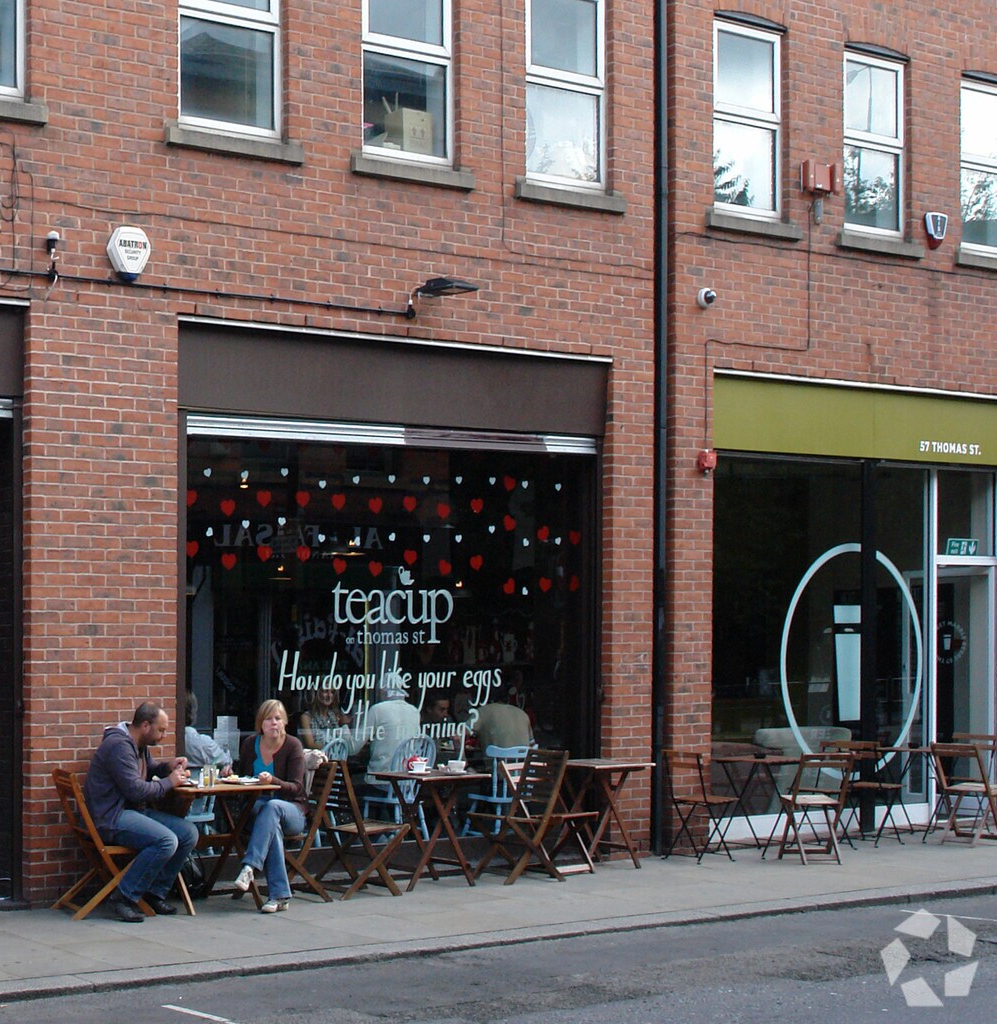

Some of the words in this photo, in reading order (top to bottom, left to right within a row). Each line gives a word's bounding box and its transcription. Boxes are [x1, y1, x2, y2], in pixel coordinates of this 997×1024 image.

[119, 239, 147, 249] ABATRON
[919, 440, 930, 452] 57
[931, 441, 968, 455] THOMAS
[969, 443, 982, 456] ST.
[331, 580, 454, 644] teacup
[356, 624, 409, 645] thomas
[412, 629, 426, 645] st
[278, 649, 321, 691] How
[322, 651, 343, 690] do
[341, 673, 376, 714] you
[380, 650, 413, 690] like
[418, 670, 457, 713] your
[462, 667, 503, 707] eggs
[354, 699, 386, 742] the
